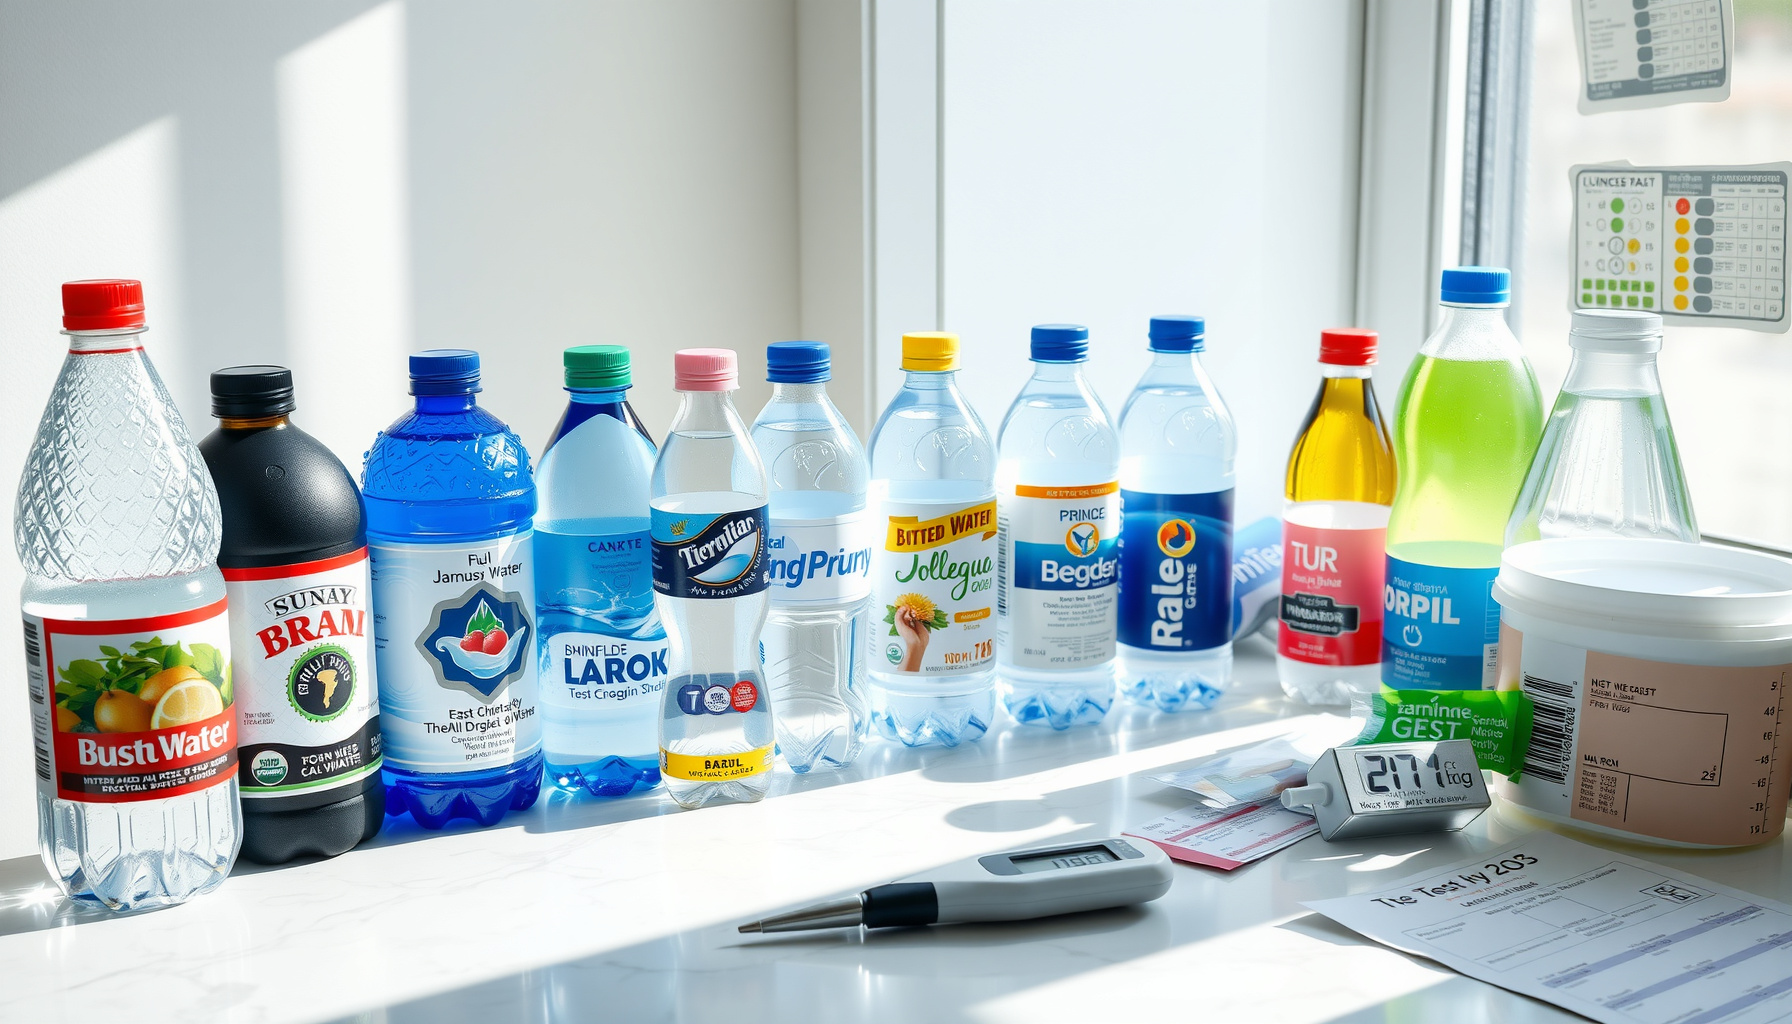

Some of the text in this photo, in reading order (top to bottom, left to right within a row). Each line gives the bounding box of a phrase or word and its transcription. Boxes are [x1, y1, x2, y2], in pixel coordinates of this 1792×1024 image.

[1060, 507, 1105, 522] PRINCE
[896, 524, 945, 546] BITTED
[1291, 540, 1338, 573] TUR
[489, 562, 522, 579] Water
[273, 587, 353, 617] SUNAY
[564, 648, 668, 685] LAROK
[569, 688, 591, 699] Test
[1391, 716, 1462, 740] GEST
[158, 721, 230, 761] Water
